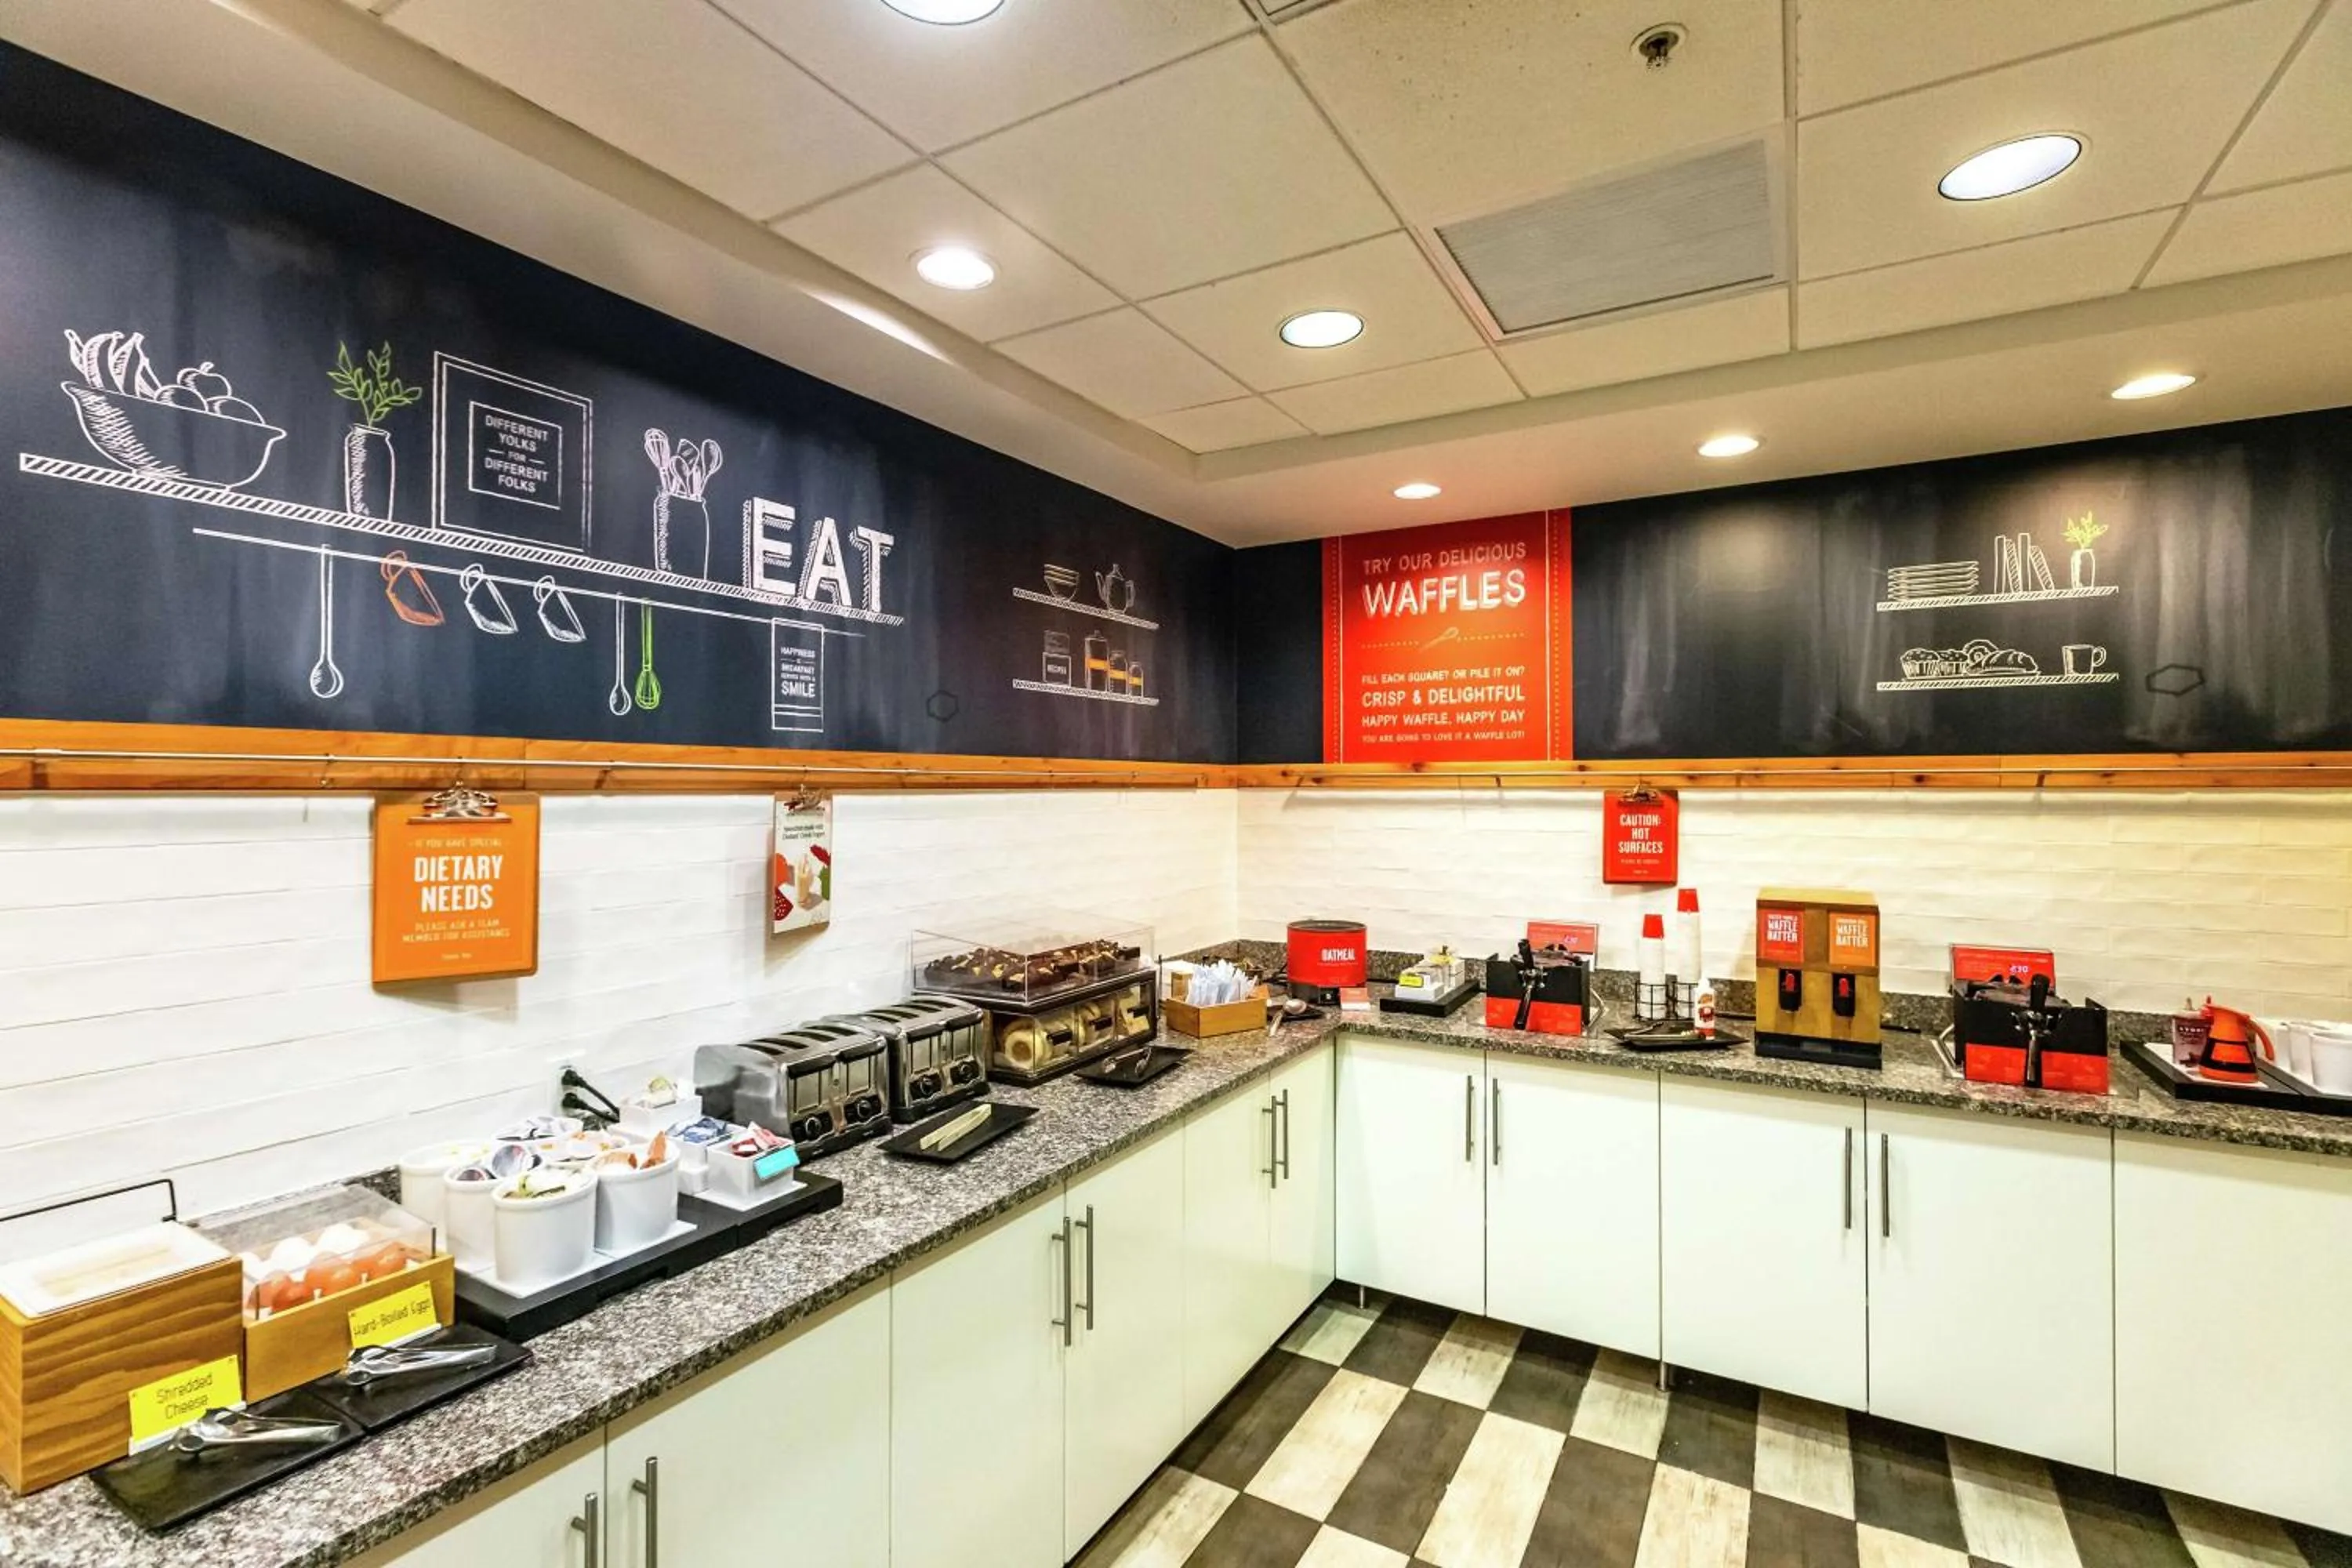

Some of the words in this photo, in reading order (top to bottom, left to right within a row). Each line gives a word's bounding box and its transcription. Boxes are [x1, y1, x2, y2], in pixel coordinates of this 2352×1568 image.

[485, 415, 548, 441] DIFFERENT
[499, 433, 537, 452] YOLKS
[508, 451, 527, 463] FOR
[485, 457, 548, 482] DIFFERENT
[498, 474, 536, 493] FOLKS
[742, 495, 895, 612] EAT
[1363, 557, 1392, 575] TRY
[1399, 553, 1432, 571] OUR
[1439, 542, 1526, 567] DELICIOUS
[1362, 568, 1526, 619] WAFFLES
[1362, 674, 1379, 684] FILL
[1381, 673, 1405, 684] EACH
[1408, 670, 1450, 683] SQUARE?
[1453, 669, 1467, 679] OR
[1470, 667, 1490, 679] PILE
[1494, 667, 1502, 678] IT
[1505, 666, 1526, 677] ON?
[781, 680, 816, 698] SMILE
[1362, 691, 1406, 707] CRISP
[1413, 690, 1421, 705] &
[1428, 684, 1526, 705] DELIGHTFUL
[1362, 714, 1398, 728] HAPPY
[1456, 710, 1496, 724] HAPPY
[1501, 710, 1526, 723] DAY
[1434, 732, 1453, 742] LOVE
[1631, 827, 1650, 840] HOT
[1617, 840, 1664, 854] SURFACES
[414, 855, 503, 882] DIETARY
[421, 884, 494, 913] NEEDS
[1768, 920, 1798, 932] WAFFLE
[1836, 924, 1868, 936] WAFFLE
[1766, 931, 1798, 942] BATTER
[1835, 935, 1869, 948] BATTER
[1321, 948, 1356, 962] OATMEAL
[157, 1372, 213, 1404] Shredded
[165, 1394, 209, 1420] Cheese
